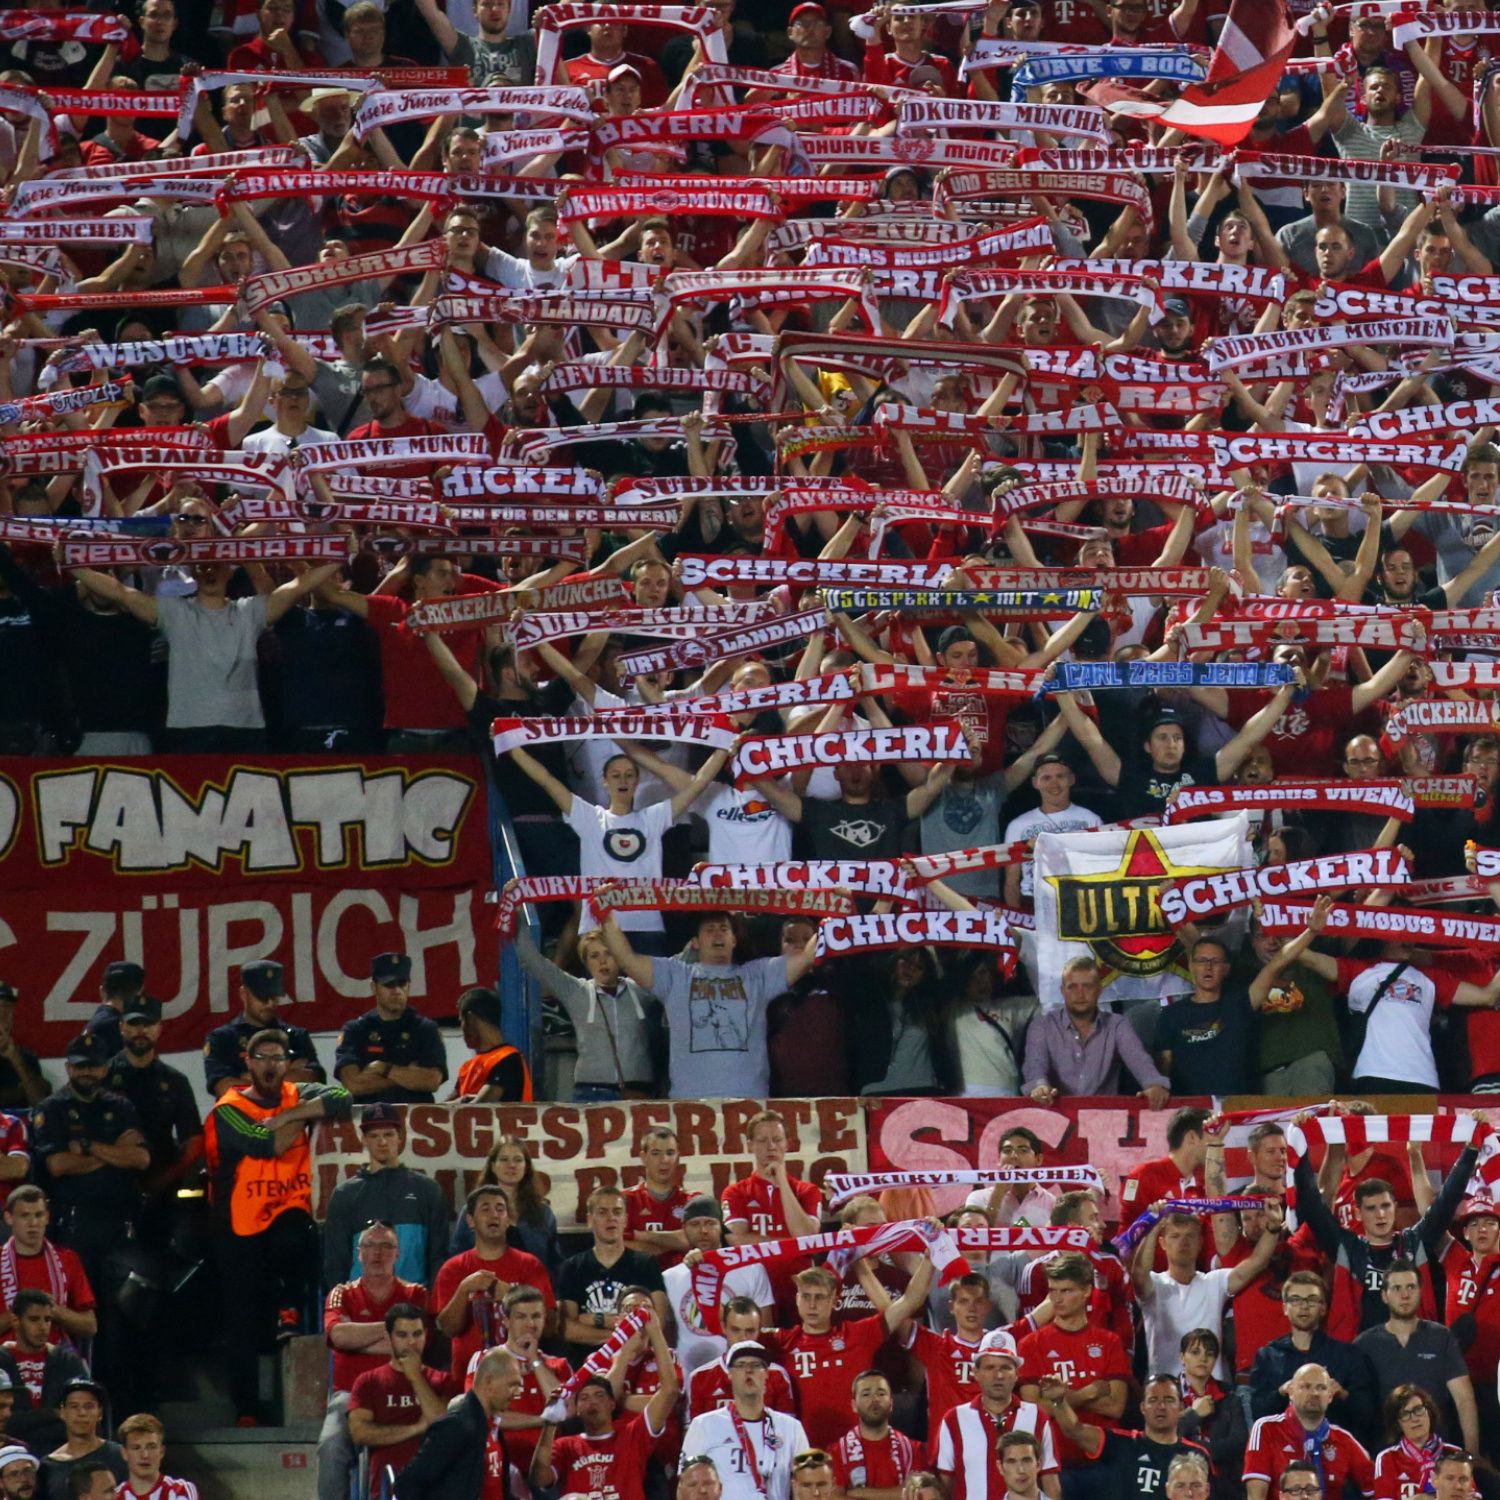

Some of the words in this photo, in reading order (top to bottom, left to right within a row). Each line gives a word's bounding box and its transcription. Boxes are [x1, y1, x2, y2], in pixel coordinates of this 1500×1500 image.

[603, 115, 743, 143] BAYERN
[804, 243, 887, 267] ULTRAS
[894, 245, 972, 266] MODUS
[1215, 434, 1464, 472] SCHICKERIA
[532, 507, 570, 522] DEN
[575, 508, 598, 522] FC
[681, 559, 952, 588] SCHICKERIA
[997, 591, 1039, 606] MIT
[1066, 663, 1122, 685] CARL
[1130, 663, 1194, 685] ZEISS
[1200, 662, 1258, 685] JENA
[735, 725, 972, 779] SCHICKERIA
[33, 766, 476, 872] FANATIC
[775, 888, 798, 905] FC
[1161, 849, 1414, 925] SCHICKERIA
[1356, 910, 1433, 935] MODUS
[44, 888, 478, 1023] ZÜRICH
[720, 1240, 783, 1268] SAN
[796, 1230, 857, 1252] MIA
